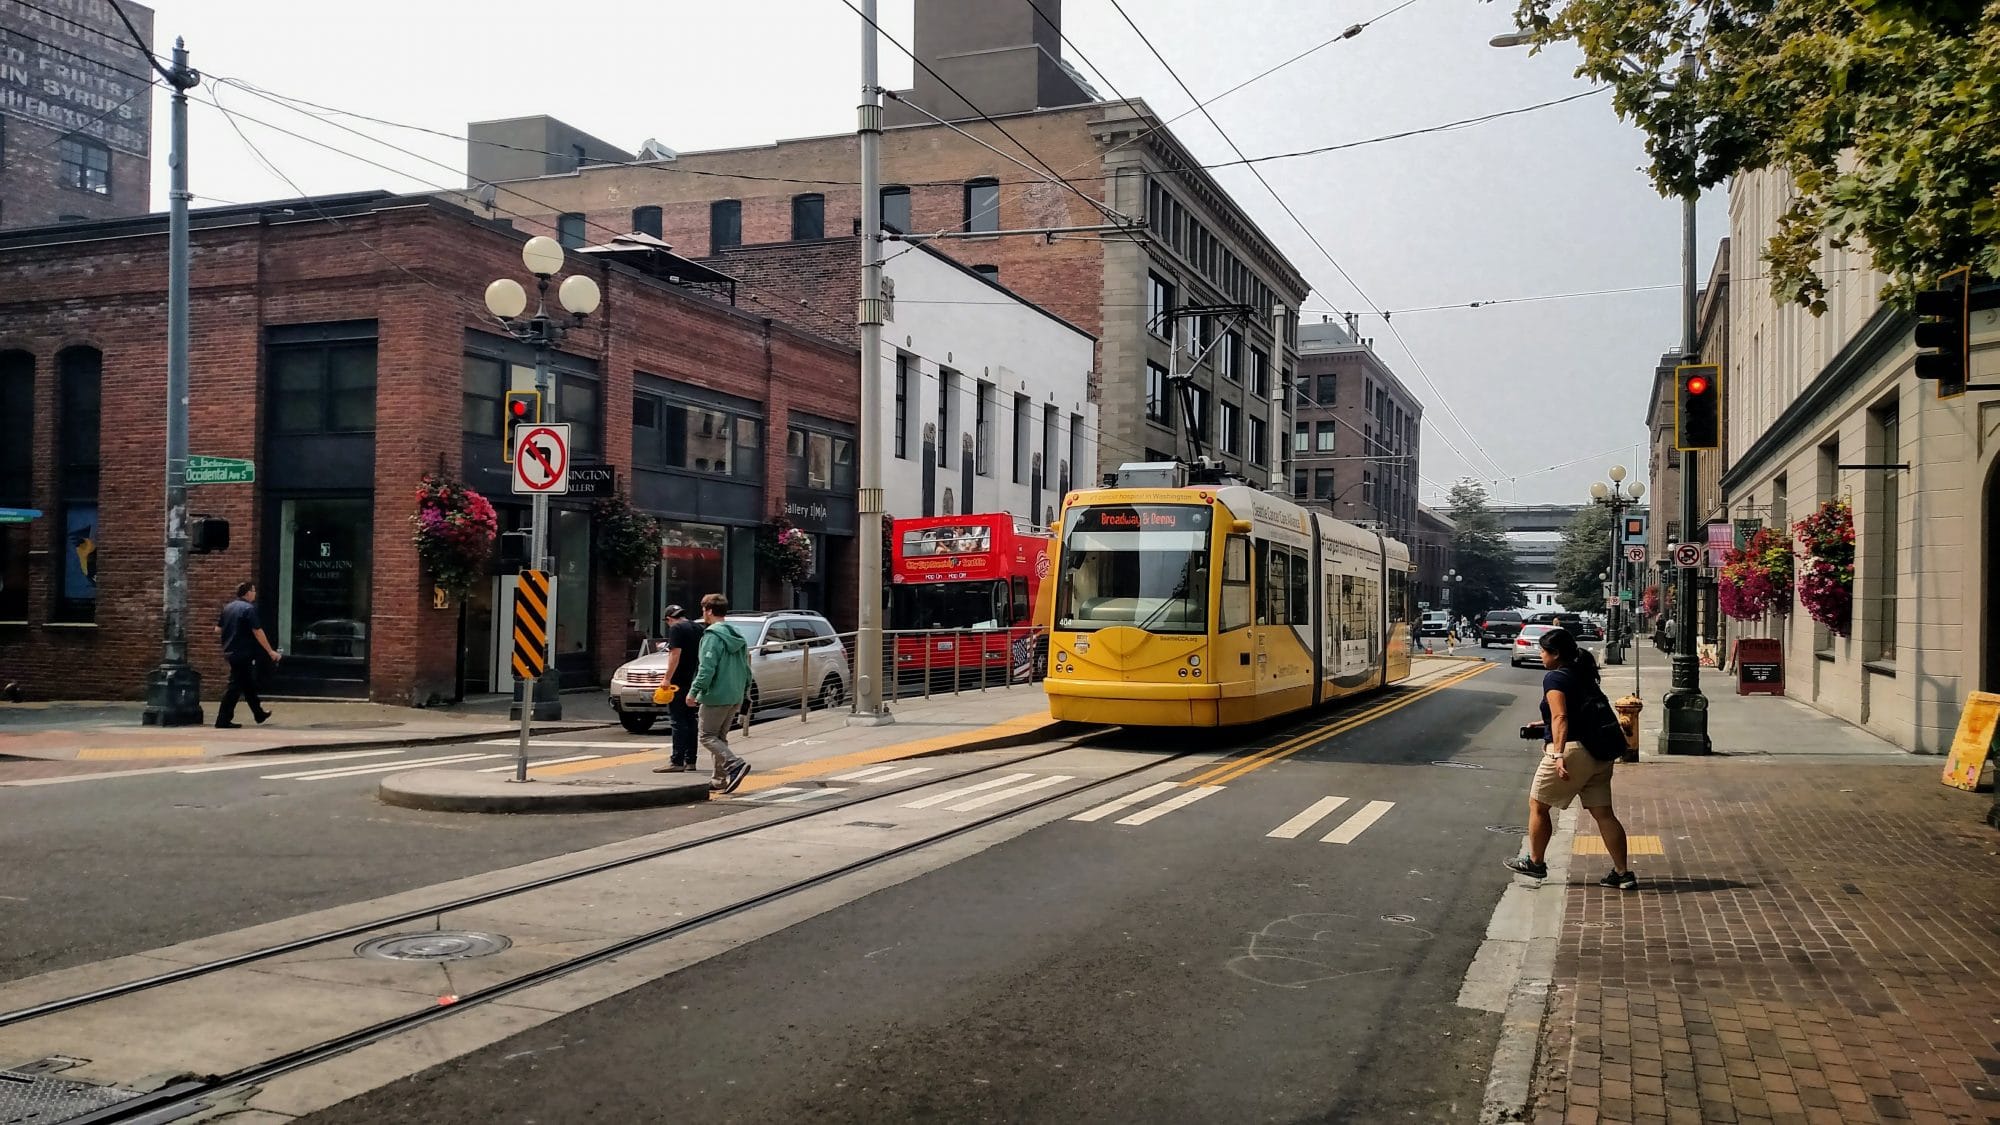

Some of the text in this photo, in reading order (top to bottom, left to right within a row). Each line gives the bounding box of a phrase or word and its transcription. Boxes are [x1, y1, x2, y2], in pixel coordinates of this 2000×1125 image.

[43, 78, 132, 119] SYRUPS
[186, 468, 228, 482] Occidental
[241, 470, 247, 480] S
[1101, 512, 1176, 527] Broadway & Denny
[1059, 618, 1072, 626] 404
